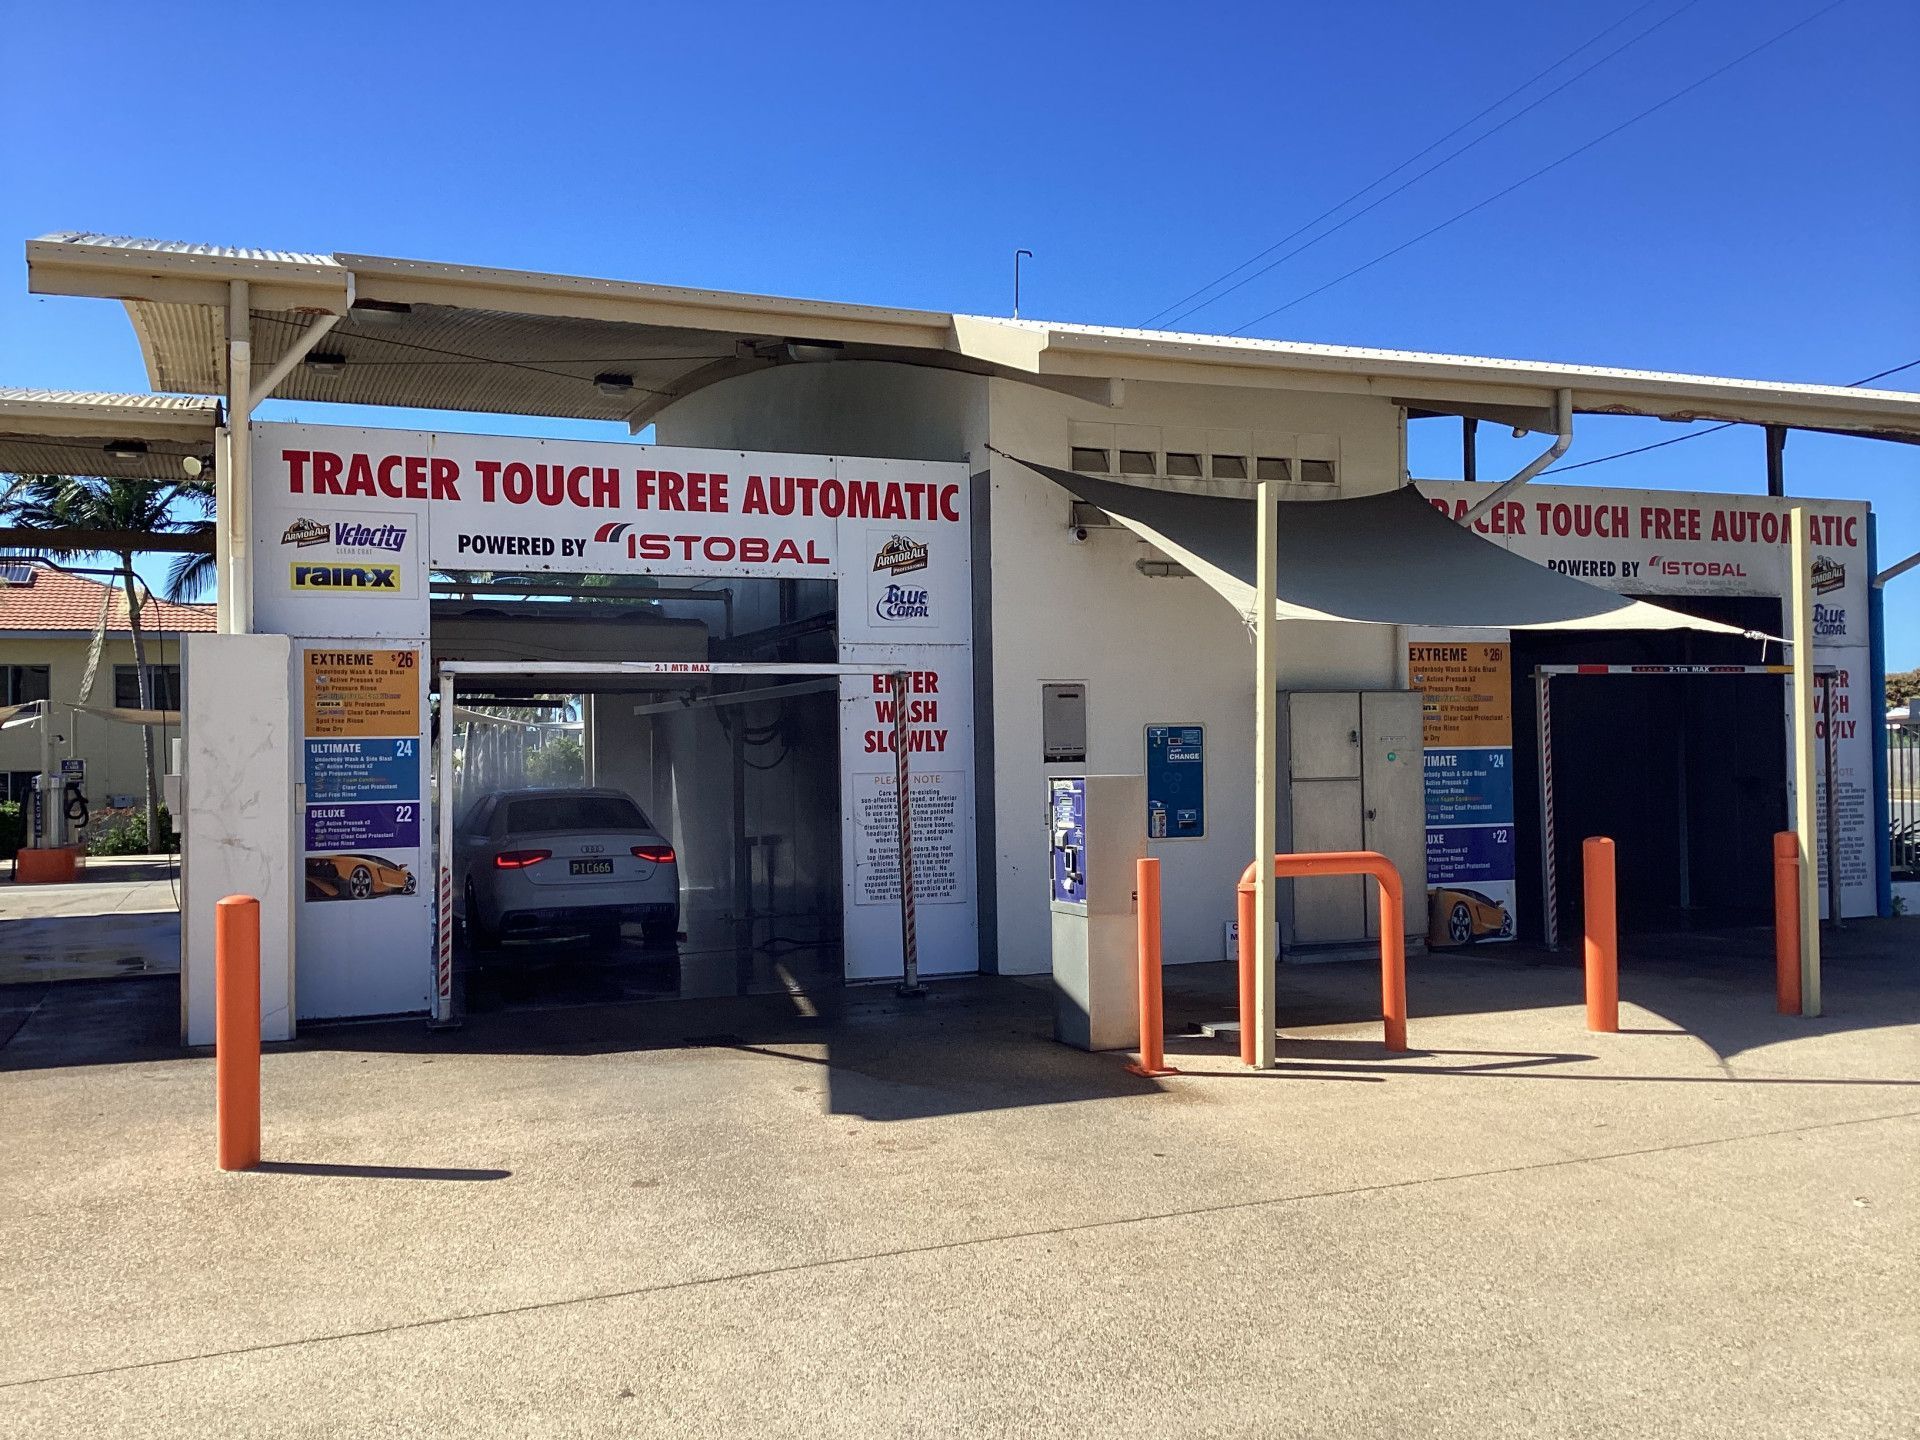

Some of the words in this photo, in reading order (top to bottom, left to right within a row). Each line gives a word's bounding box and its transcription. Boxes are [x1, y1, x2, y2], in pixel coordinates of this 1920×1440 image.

[282, 449, 461, 501] TRACER
[475, 460, 620, 509] TOUCH
[636, 469, 729, 514] FREE
[742, 475, 960, 522] AUTOMATIC
[1536, 502, 1629, 538] TOUCH
[1640, 507, 1701, 541] FREE
[335, 522, 407, 552] Velocity
[458, 533, 555, 556] POWERED
[562, 538, 587, 557] BY
[627, 533, 830, 565] ISTOBAL
[1548, 559, 1616, 577] POWERED
[1622, 561, 1640, 577] BY
[1662, 561, 1747, 577] ISTOBAL
[883, 584, 927, 605] BLUE
[887, 602, 929, 617] CORAL
[1812, 603, 1845, 623] BLUE
[1814, 621, 1846, 635] CORAL
[311, 653, 374, 666] EXTREME
[390, 651, 414, 668] $26
[1409, 647, 1468, 661] EXTREME
[654, 663, 668, 672] 2.1
[671, 663, 688, 672] MTR
[691, 663, 710, 672] MAX
[875, 700, 938, 723] WSH
[310, 743, 361, 754] ULTIMATE
[396, 740, 412, 757] 24
[1169, 752, 1200, 760] CHANGE
[1424, 755, 1457, 767] TIMATE
[1489, 754, 1504, 768] $24
[874, 776, 897, 785] PLEA
[311, 809, 346, 818] DELUXE
[396, 805, 412, 822] 22
[1428, 834, 1444, 844] UXE
[1493, 829, 1507, 843] $22
